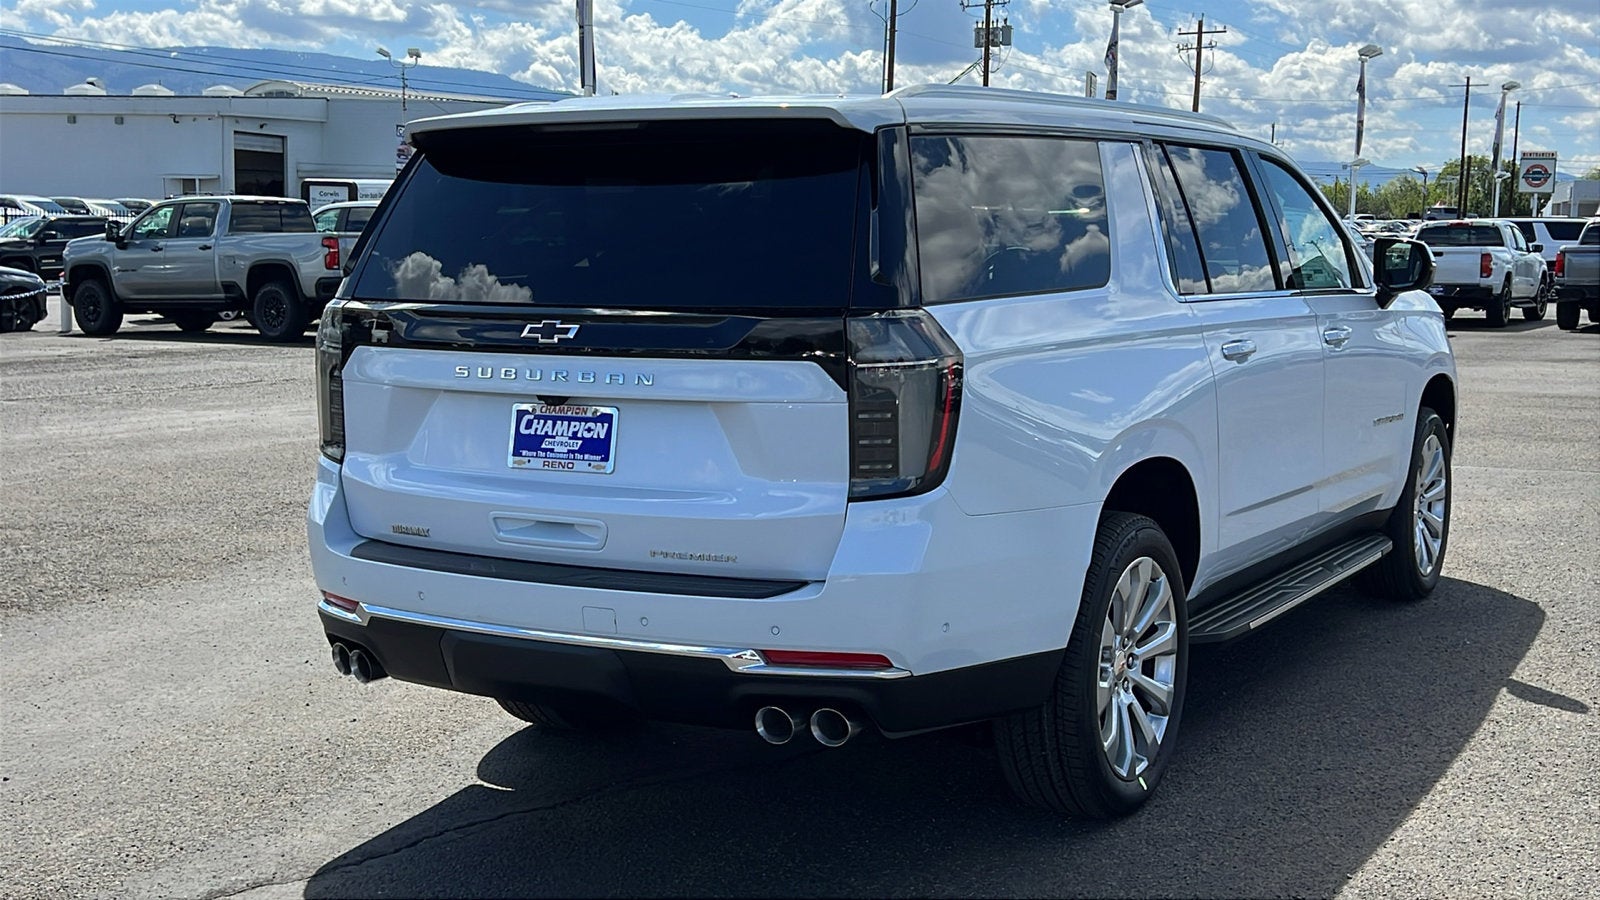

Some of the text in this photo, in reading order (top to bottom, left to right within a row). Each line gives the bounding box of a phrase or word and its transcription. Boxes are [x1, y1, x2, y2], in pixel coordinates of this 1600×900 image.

[455, 365, 655, 386] SUBURBAN
[540, 405, 588, 415] CHAMPION
[544, 440, 579, 448] CHEVROLET
[542, 460, 575, 470] RENO
[649, 549, 738, 563] PREMIER
